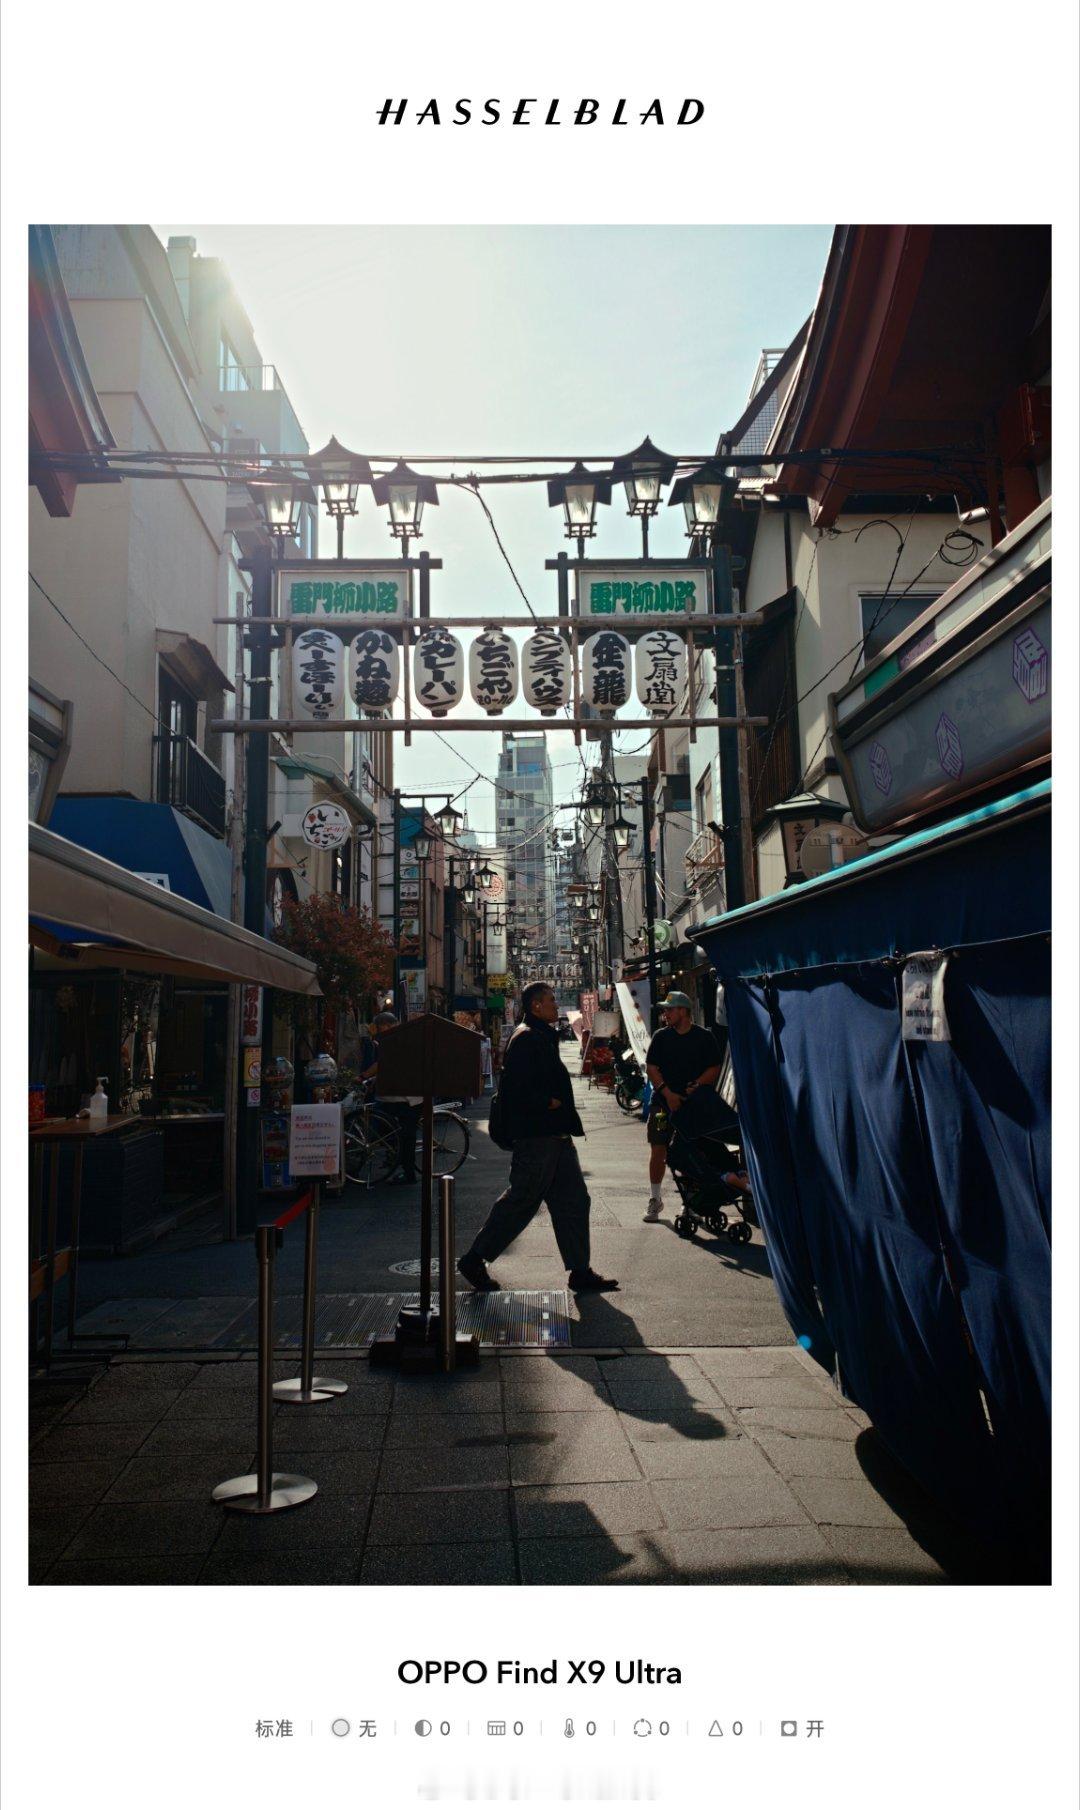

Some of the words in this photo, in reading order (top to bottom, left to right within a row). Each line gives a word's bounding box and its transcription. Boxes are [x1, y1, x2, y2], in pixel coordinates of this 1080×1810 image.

[420, 640, 457, 708] カレーパン
[475, 632, 515, 695] いちごや
[641, 631, 682, 705] 文扇堂
